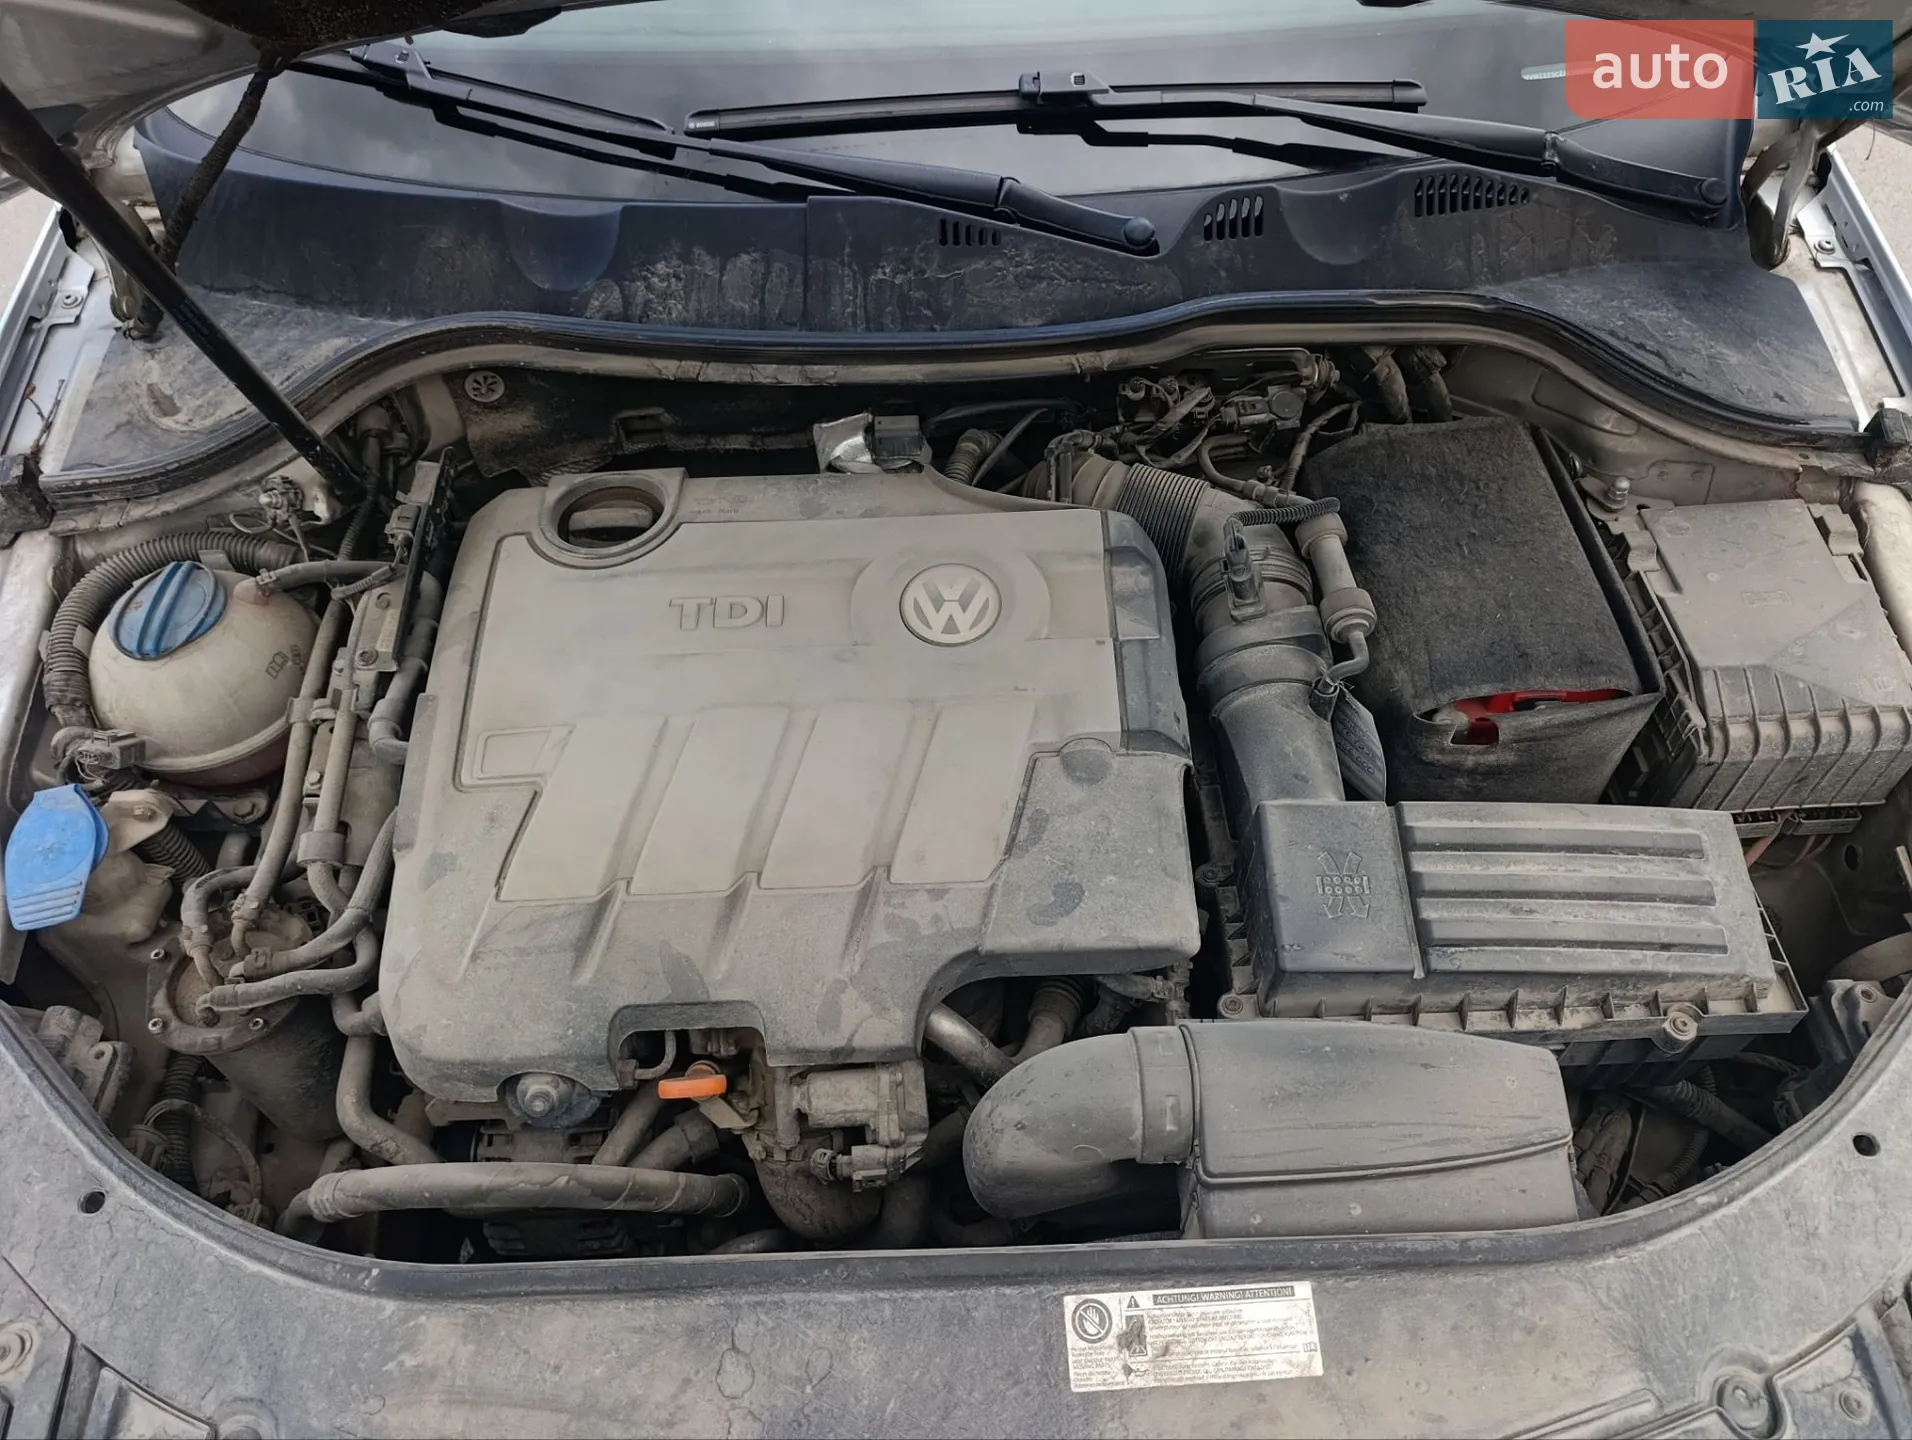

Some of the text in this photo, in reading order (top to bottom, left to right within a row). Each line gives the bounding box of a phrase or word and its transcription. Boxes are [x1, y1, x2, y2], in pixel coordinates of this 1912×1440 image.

[669, 594, 785, 631] TDI
[903, 566, 999, 645] VW
[1156, 1287, 1293, 1304] ACHTUNG! WARNING! ATTENTION!
